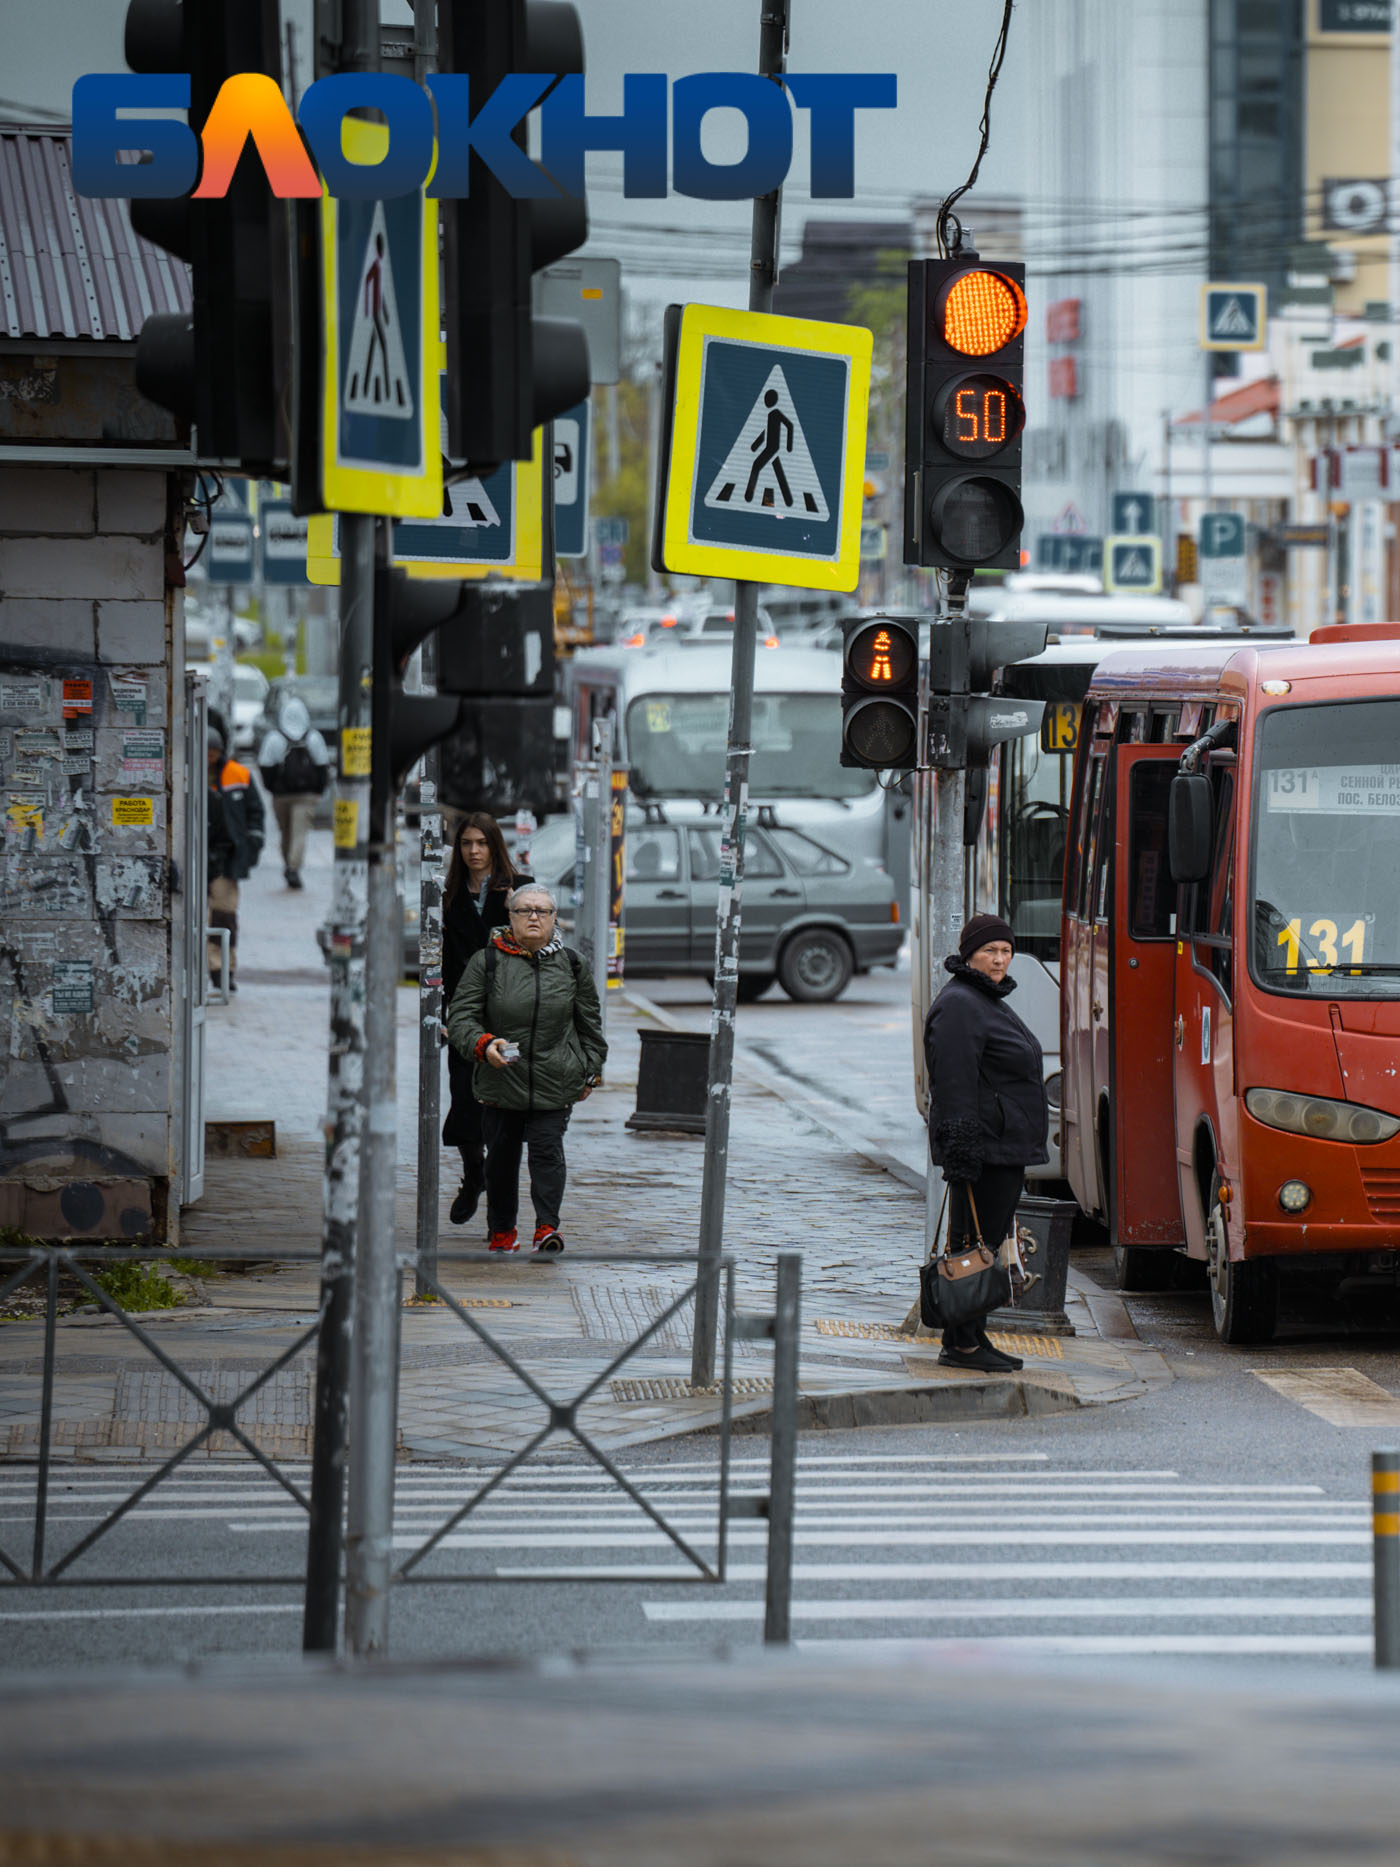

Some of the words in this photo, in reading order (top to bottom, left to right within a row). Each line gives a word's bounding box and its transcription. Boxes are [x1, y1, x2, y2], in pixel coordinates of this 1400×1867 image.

[956, 389, 1005, 441] 50
[1337, 792, 1364, 806] ПОС.
[1340, 775, 1385, 790] СЕННОЙ
[1277, 918, 1366, 976] 131
